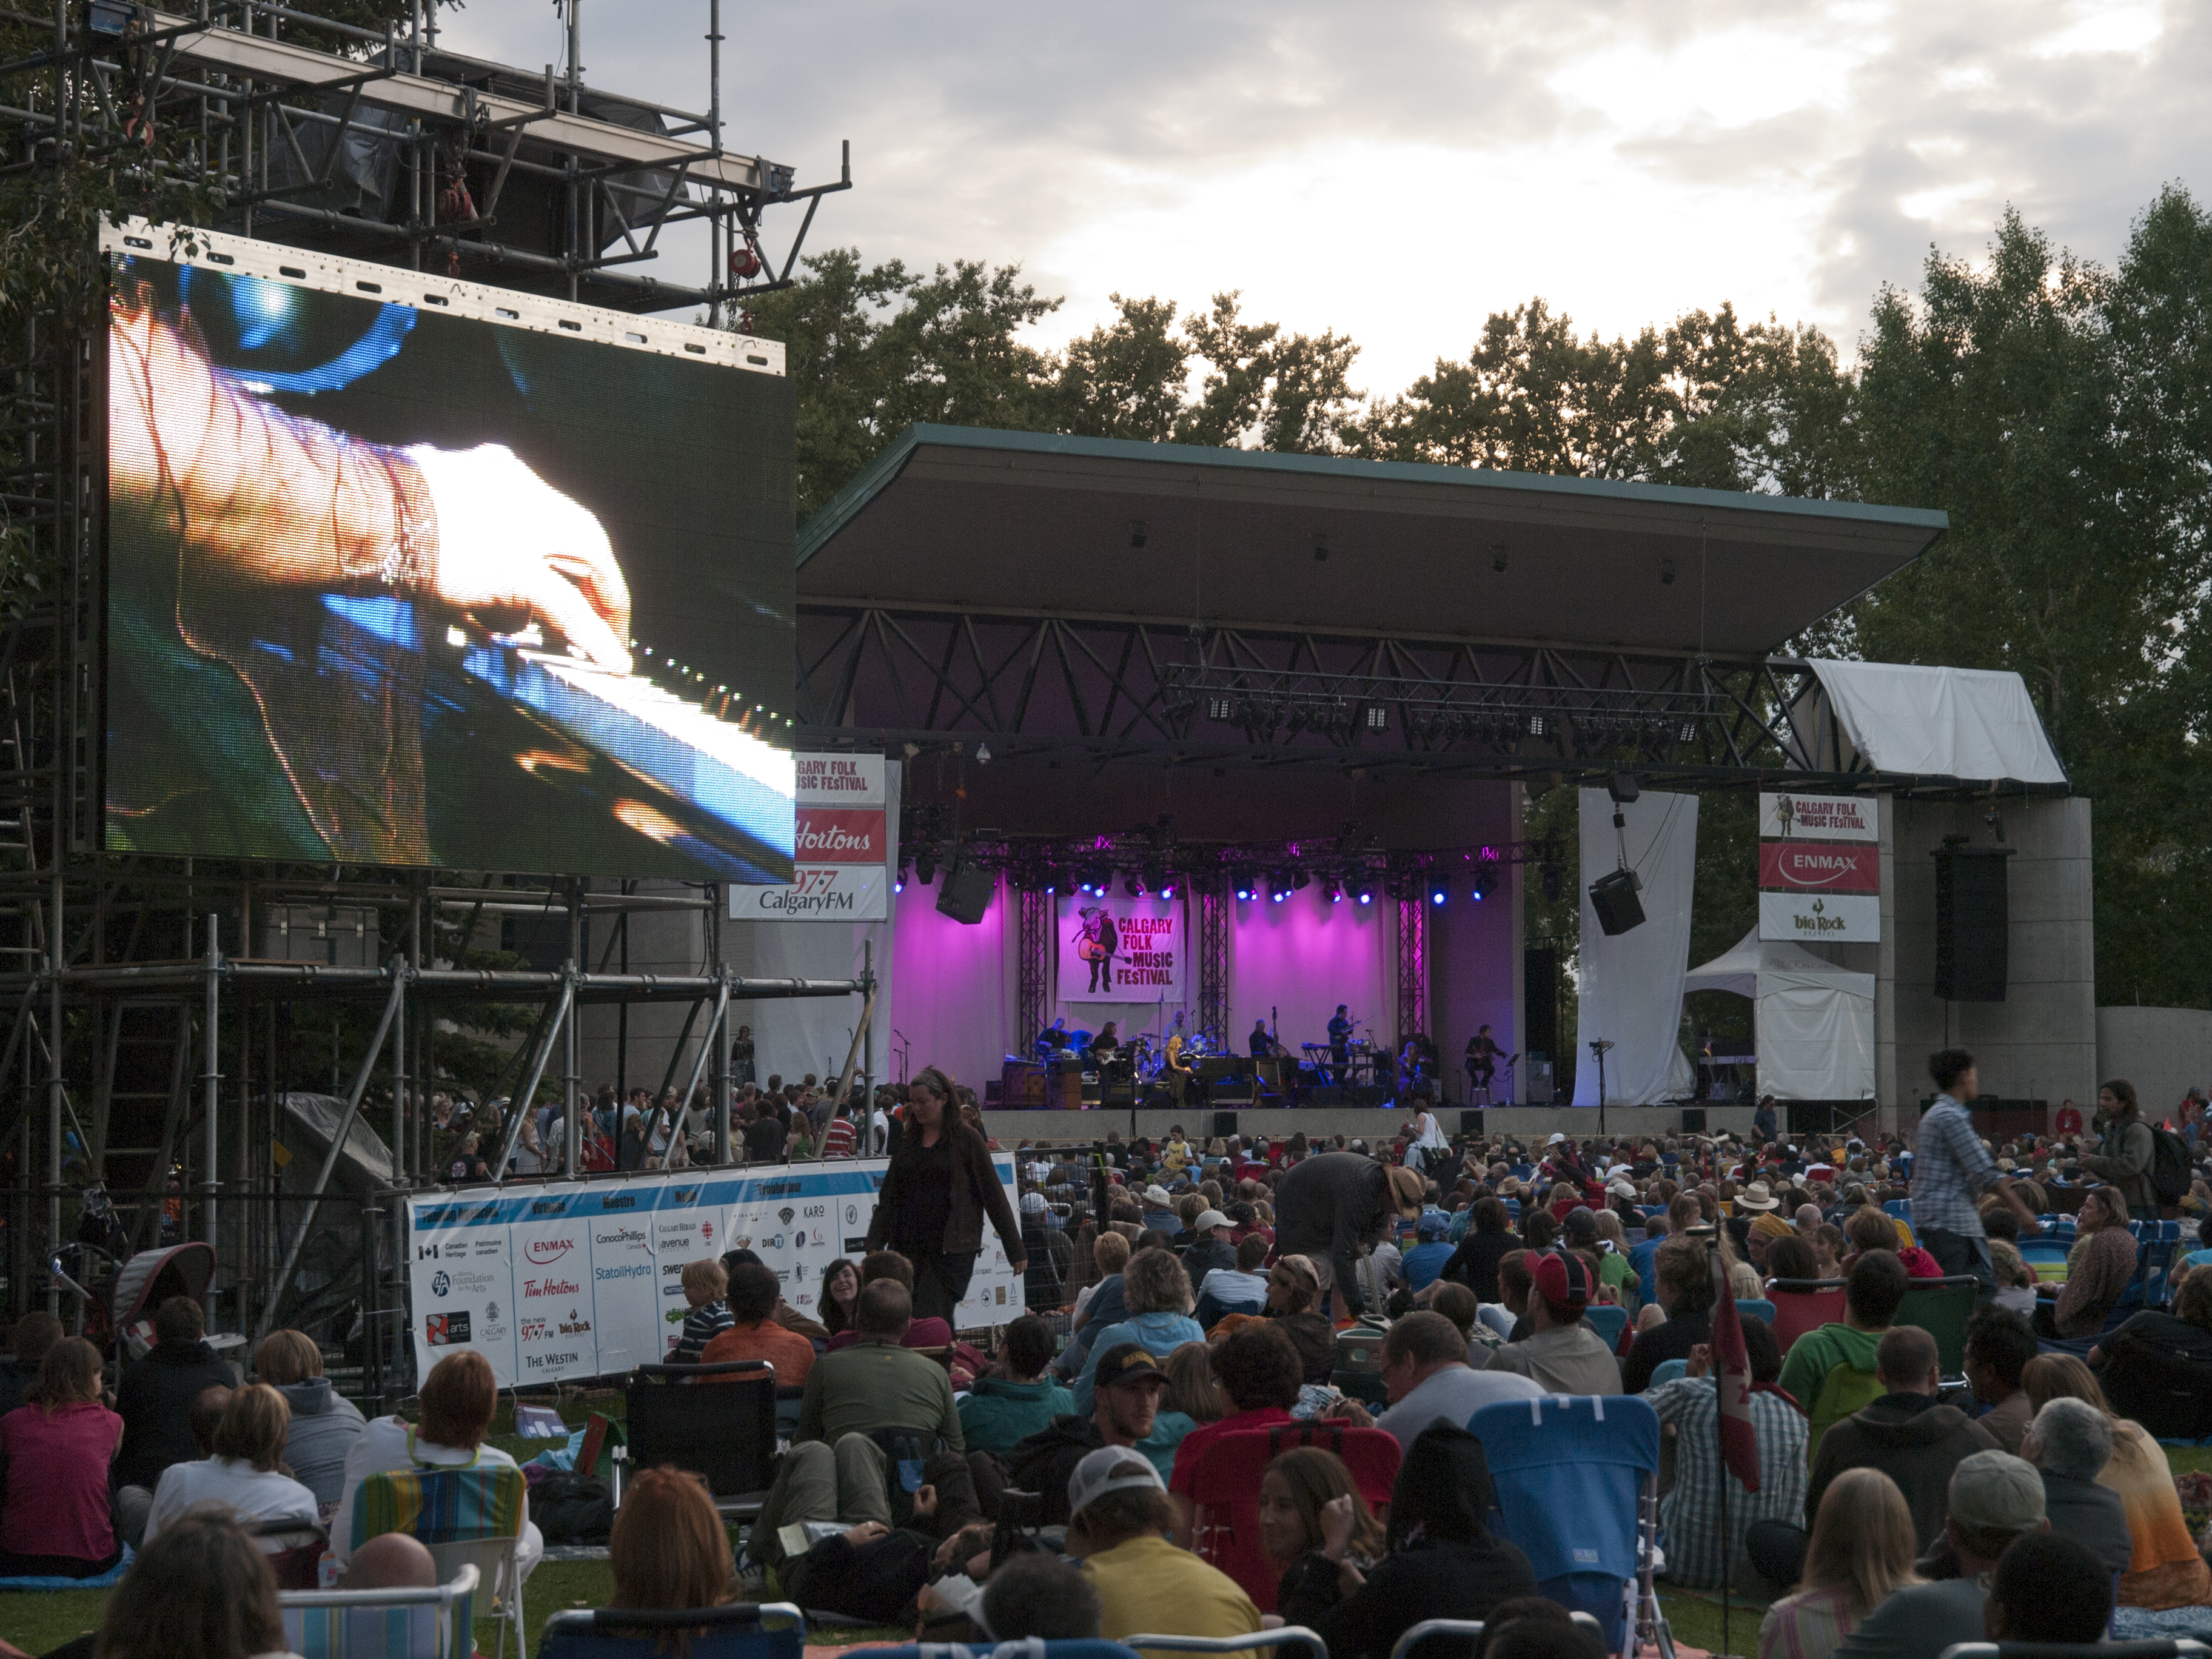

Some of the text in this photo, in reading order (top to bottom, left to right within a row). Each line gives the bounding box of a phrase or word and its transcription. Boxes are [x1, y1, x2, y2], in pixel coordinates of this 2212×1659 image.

[797, 760, 856, 776] GARY FOLK
[821, 777, 868, 791] FESTIVAL
[1796, 801, 1856, 816] CALGARY FOLK
[1801, 814, 1865, 829] MUSIC FESTIVAL
[795, 820, 870, 850] Hortons
[1794, 854, 1859, 870] ENMAX
[1118, 917, 1173, 934] CALGARY
[1817, 916, 1846, 930] Rock
[1123, 934, 1152, 950] FOLK
[1133, 952, 1173, 968] MUSIC
[1117, 969, 1173, 985] FESTIVAL
[758, 1182, 802, 1196] Troubadour
[532, 1201, 566, 1215] Virtuoso
[603, 1196, 635, 1209] Maestro
[423, 1205, 498, 1223] Funding Agencies
[803, 1205, 824, 1218] KARO
[659, 1222, 696, 1233] CALGARY HERALD
[596, 1231, 646, 1244] ConocoPhillips
[661, 1238, 689, 1248] avenue
[534, 1238, 574, 1252] ENMAX
[595, 1264, 651, 1280] StatoilHydro
[663, 1263, 686, 1275] swer
[452, 1274, 494, 1285] Foundation
[472, 1284, 486, 1293] Arts
[524, 1278, 579, 1298] Tim Hortons
[665, 1286, 684, 1295] PATTISO
[450, 1323, 469, 1333] arts
[480, 1327, 507, 1336] CALGARY
[545, 1330, 554, 1339] FM
[526, 1352, 578, 1368] THE WESTIN
